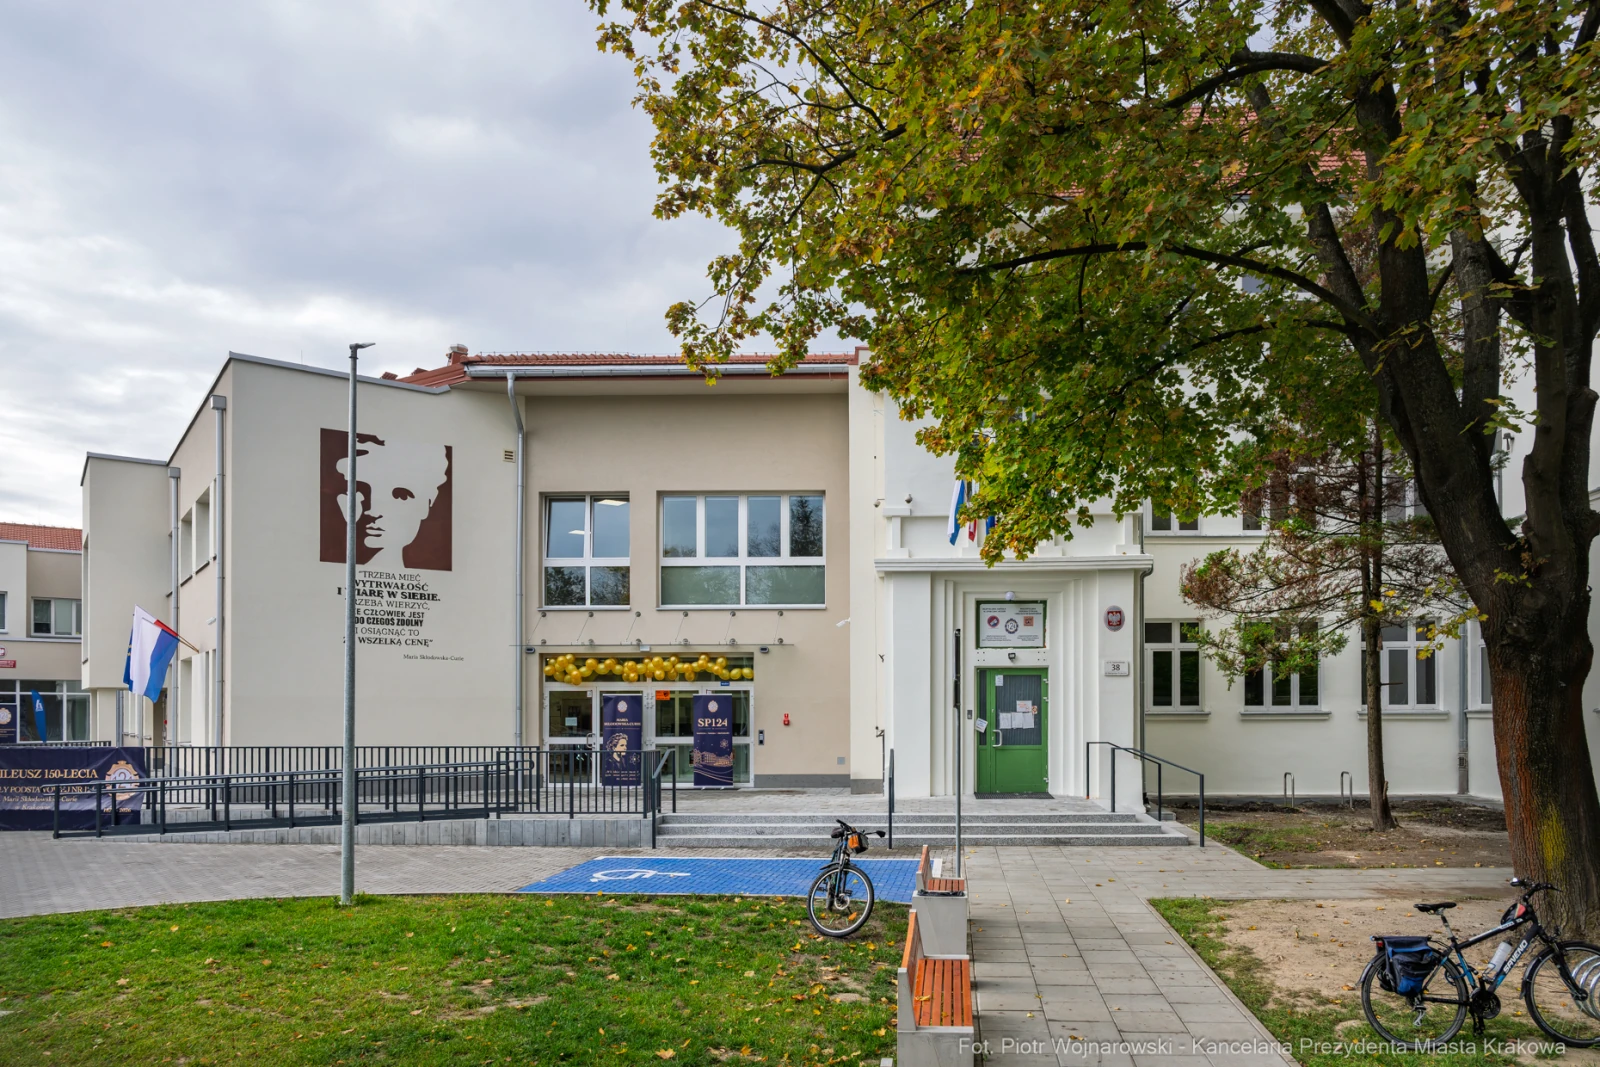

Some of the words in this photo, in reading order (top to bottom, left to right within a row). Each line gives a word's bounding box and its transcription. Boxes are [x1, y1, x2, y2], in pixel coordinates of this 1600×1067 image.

[399, 573, 421, 582] MIEĆ
[337, 586, 342, 595] I
[387, 590, 398, 599] W
[401, 591, 441, 602] SIEBIE.
[386, 600, 430, 611] WIERZYĆ,
[363, 608, 406, 618] CZŁOWIEK
[408, 611, 425, 619] JEST
[366, 616, 395, 626] CZEGOŚ
[396, 618, 424, 627] ZDOLNY
[361, 627, 406, 637] OSIĄGNĄĆ
[408, 629, 420, 637] TO
[358, 636, 402, 647] WSZELKĄ
[419, 654, 464, 662] Skłodowska-Curie
[1111, 663, 1121, 672] 38
[697, 717, 728, 727] SP124
[0, 769, 42, 779] ILEUSZ
[44, 769, 99, 779] 150-LECIA
[1503, 939, 1528, 974] SAVENO
